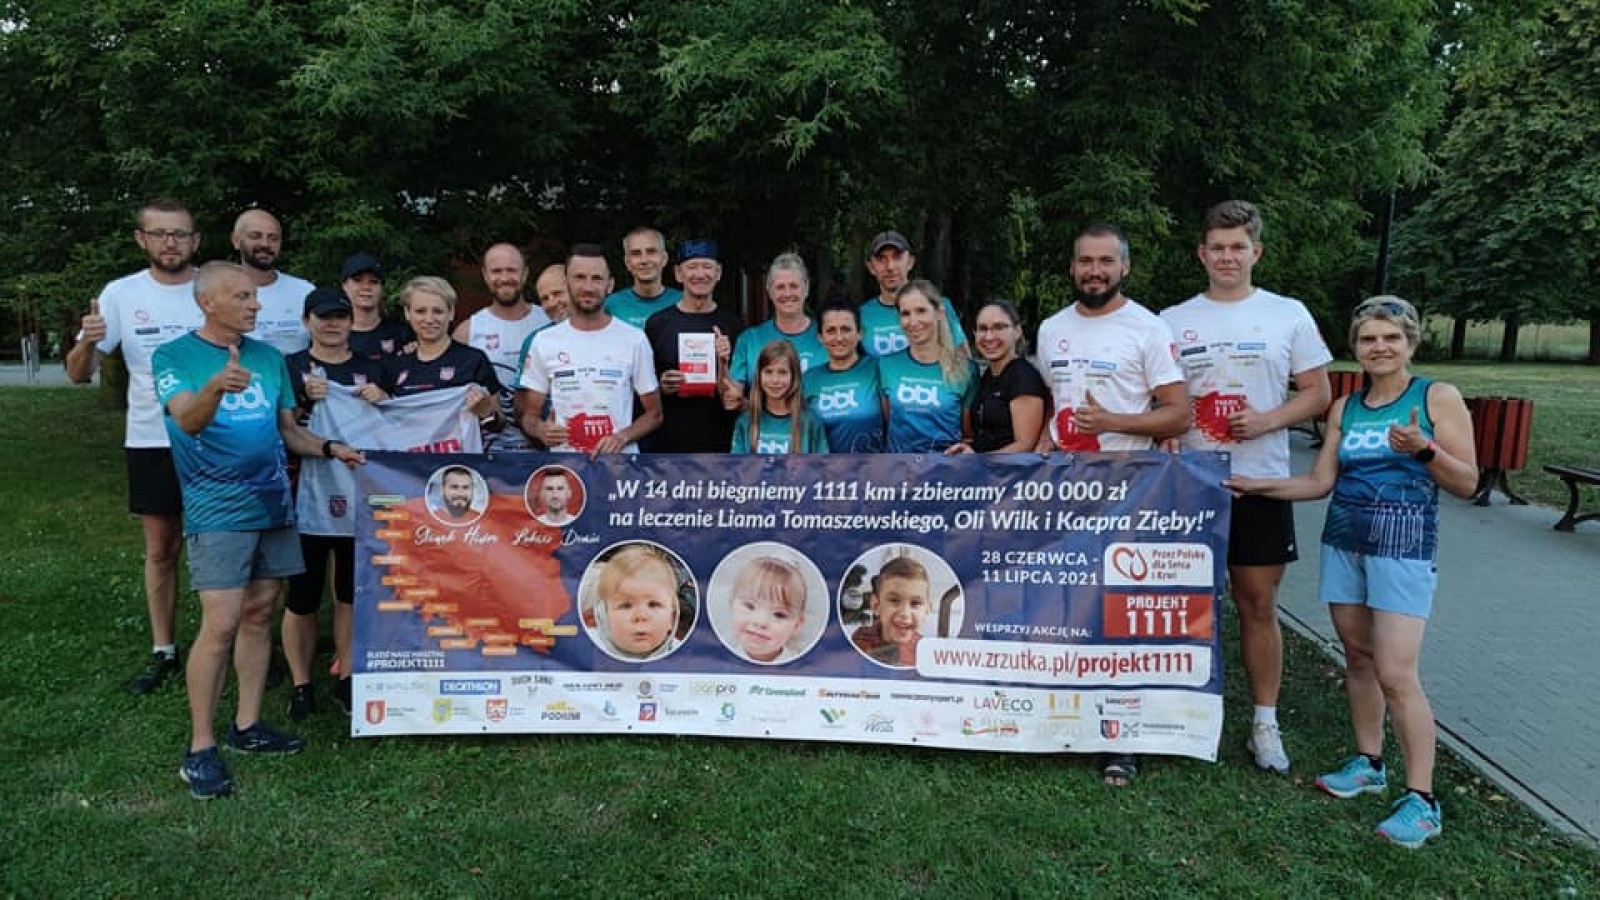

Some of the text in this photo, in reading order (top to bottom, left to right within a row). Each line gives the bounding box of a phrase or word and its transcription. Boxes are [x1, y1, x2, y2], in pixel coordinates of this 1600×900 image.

[818, 390, 858, 411] bbl
[897, 384, 941, 406] bbl
[644, 480, 668, 499] 14
[672, 480, 702, 500] dni
[706, 481, 806, 504] biegniemy
[812, 482, 859, 501] 1111
[865, 481, 896, 501] km
[901, 481, 908, 501] i
[912, 482, 1005, 504] zbieramy
[1012, 482, 1054, 501] 100
[1058, 482, 1102, 501] 000
[1107, 481, 1129, 501] zł
[609, 509, 633, 526] na
[638, 508, 713, 527] leczenie
[717, 509, 776, 528] Liama
[781, 509, 948, 533] Tomaszewskiego,
[954, 510, 985, 530] Oli
[991, 510, 1039, 531] Wilk
[1044, 510, 1051, 531] i
[1056, 511, 1131, 534] Kacpra
[982, 551, 1000, 564] 28
[1005, 551, 1088, 566] CZERWCA
[982, 570, 1098, 586] 11 LIPCA 2021
[1126, 595, 1189, 609] PROJEKT
[1126, 610, 1188, 635] 1111
[934, 648, 1193, 678] www.zrzutka.pl/projekt1111
[974, 695, 1033, 712] LAVECO
